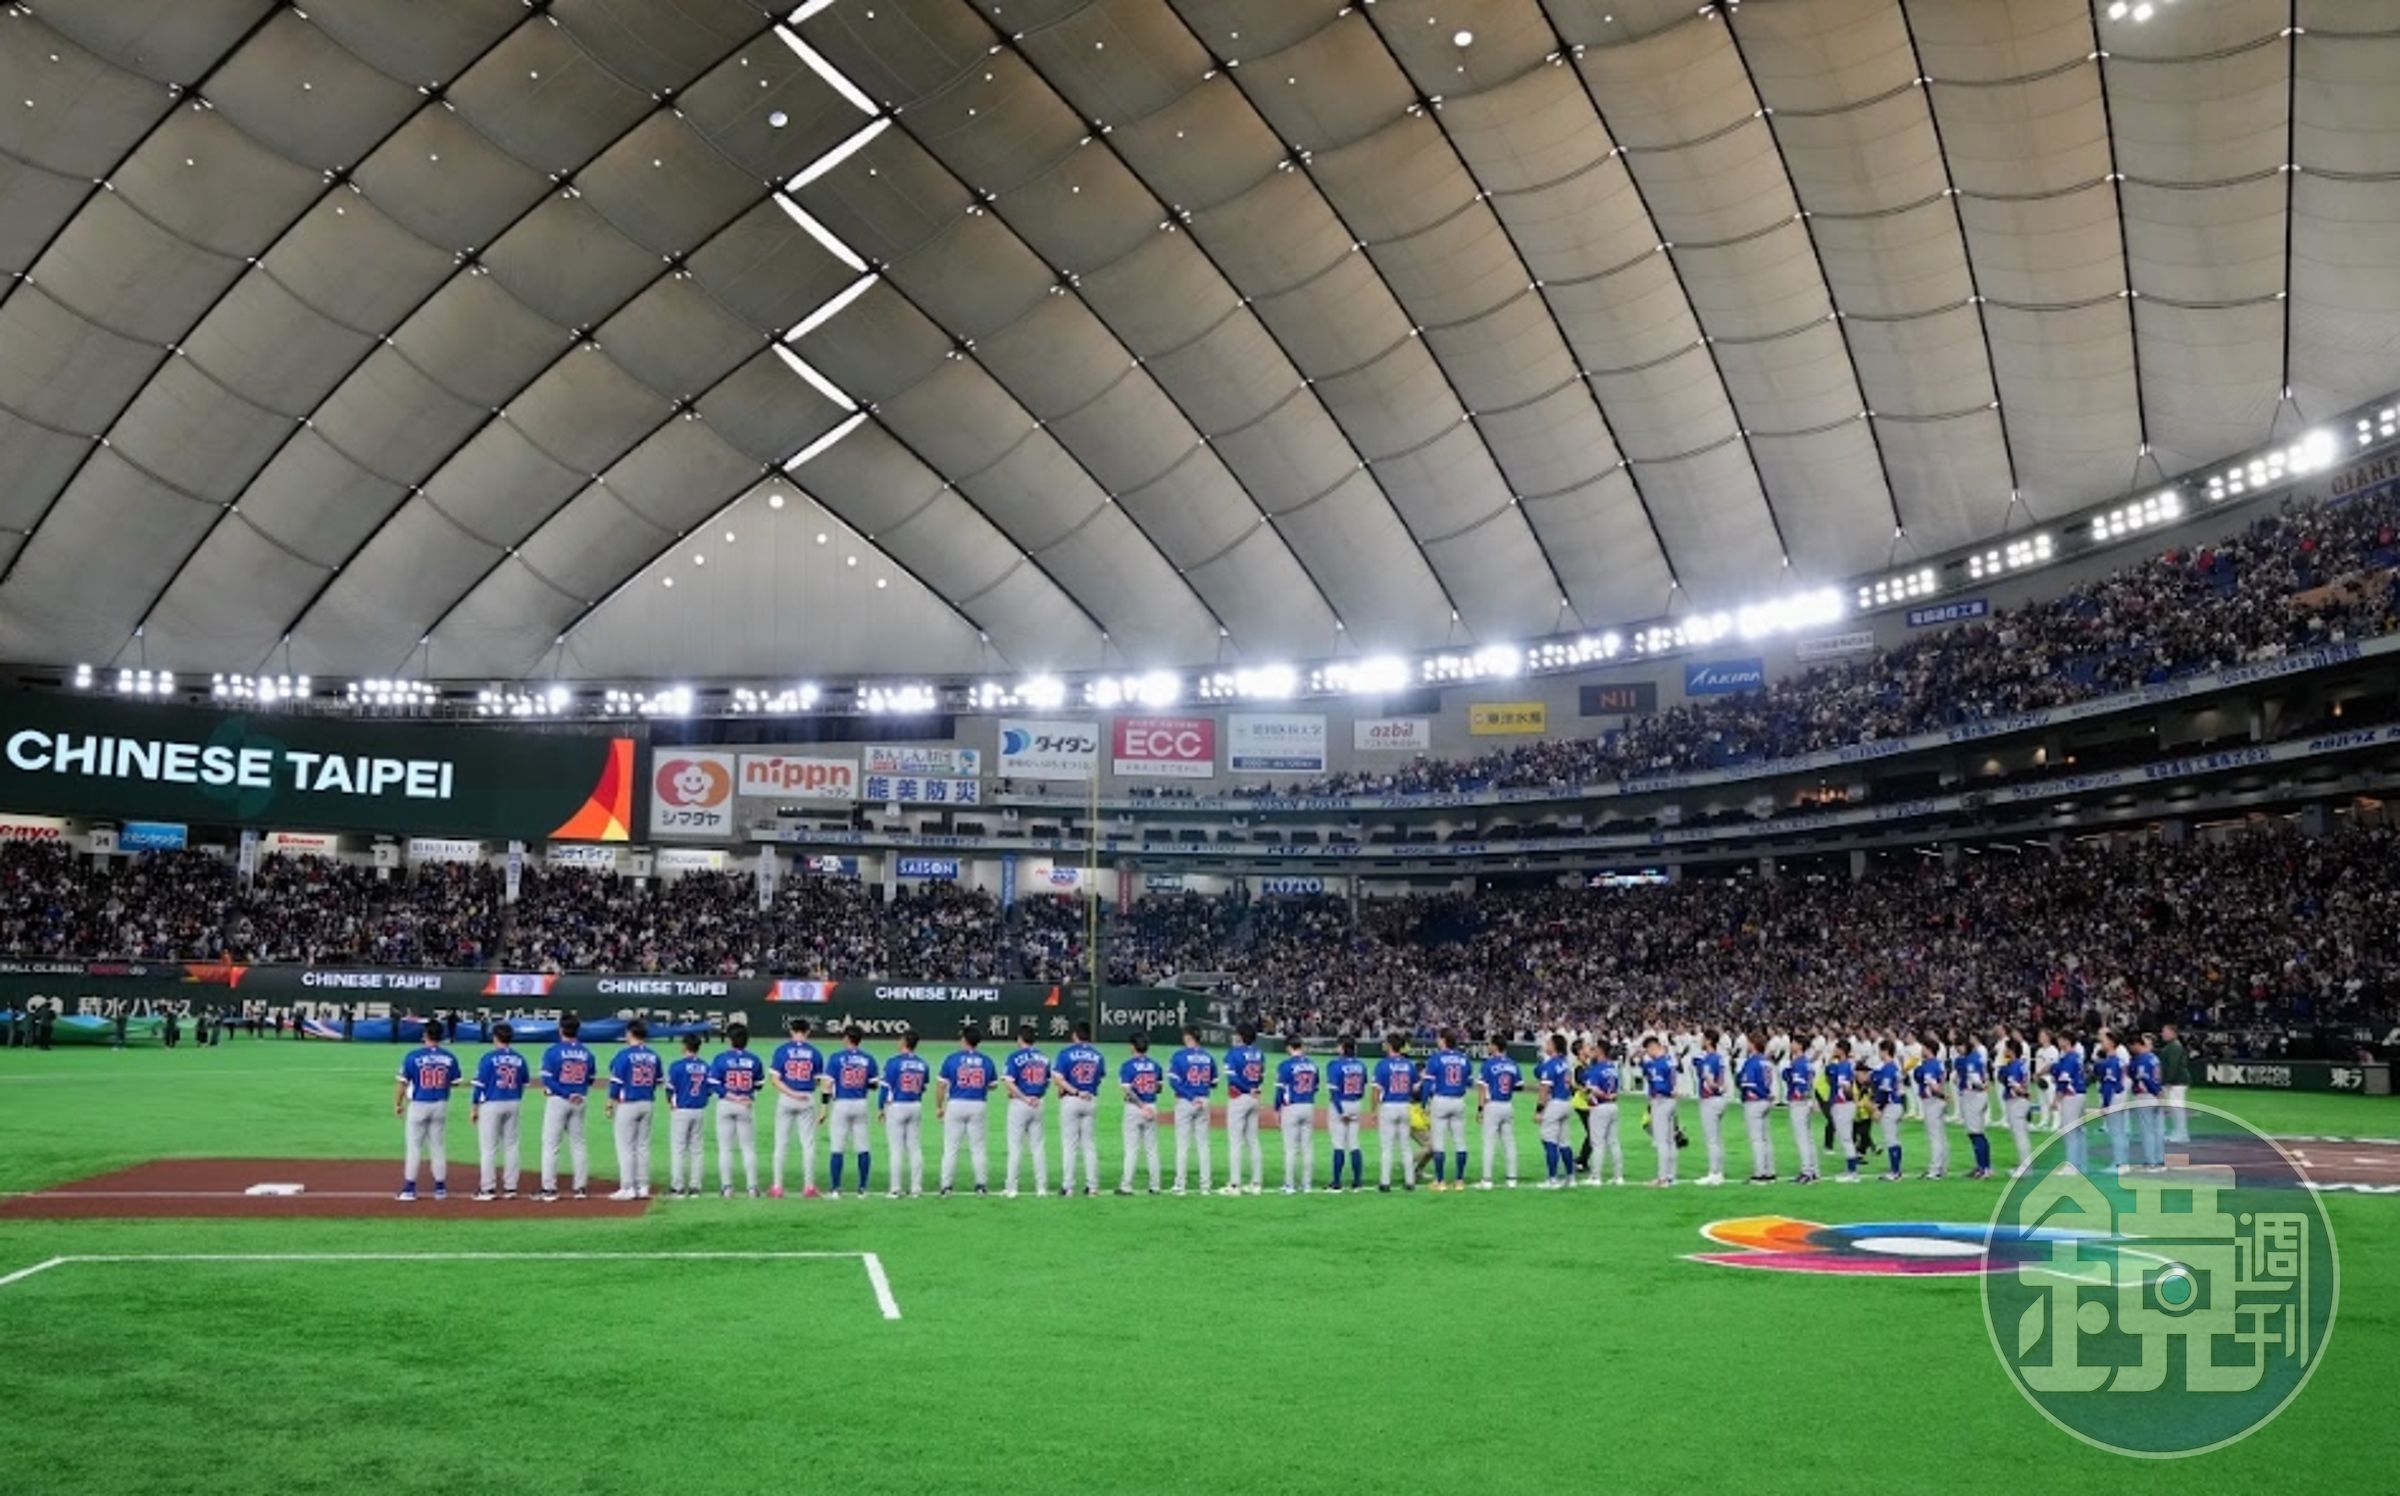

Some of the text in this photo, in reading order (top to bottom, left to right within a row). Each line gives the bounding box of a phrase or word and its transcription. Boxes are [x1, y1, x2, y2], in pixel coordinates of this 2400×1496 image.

[1369, 722, 1414, 738] azbil
[1035, 734, 1096, 753] ダイダン
[1125, 729, 1202, 758] ECC
[6, 729, 453, 798] CHINESE TAIPEI
[746, 758, 851, 790] nippn
[868, 776, 976, 803] 能美防災
[662, 810, 721, 827] シマダヤ
[899, 859, 953, 874] SAISON
[1267, 878, 1322, 893] TOTO
[33, 963, 84, 974] CLASSIC
[302, 972, 441, 989] CHINESE TAIPEI
[597, 979, 728, 996] CHINESE TAIPEI
[875, 986, 999, 1001] CHINESE TAIPEI
[78, 996, 191, 1017] 積水ハウス
[2207, 1064, 2246, 1084] NX
